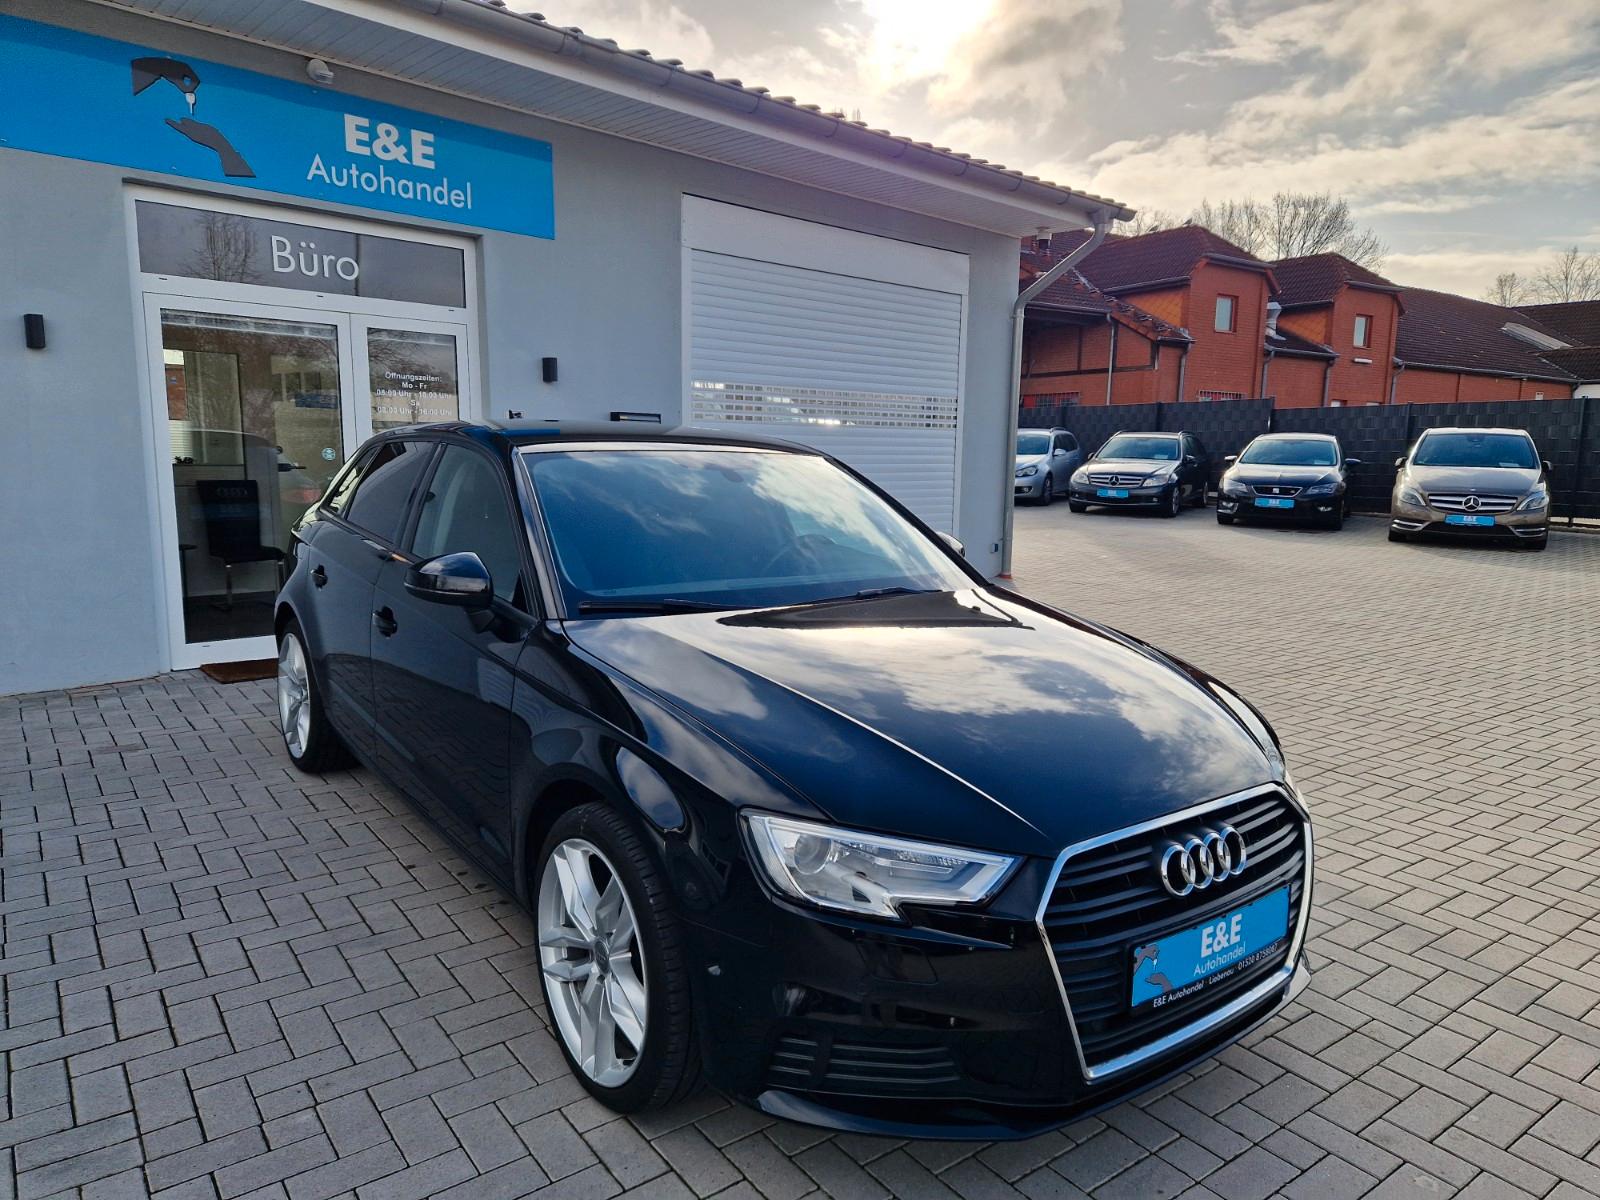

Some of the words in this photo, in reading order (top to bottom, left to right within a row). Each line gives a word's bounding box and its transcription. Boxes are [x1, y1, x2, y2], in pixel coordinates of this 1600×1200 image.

[343, 113, 436, 170] E&E
[306, 153, 472, 210] Autohandel
[270, 235, 360, 281] Büro
[1201, 913, 1242, 958] E&E
[1193, 941, 1246, 977] Autohandel
[1153, 995, 1168, 1008] E&E
[1167, 980, 1205, 1003] Autohandel
